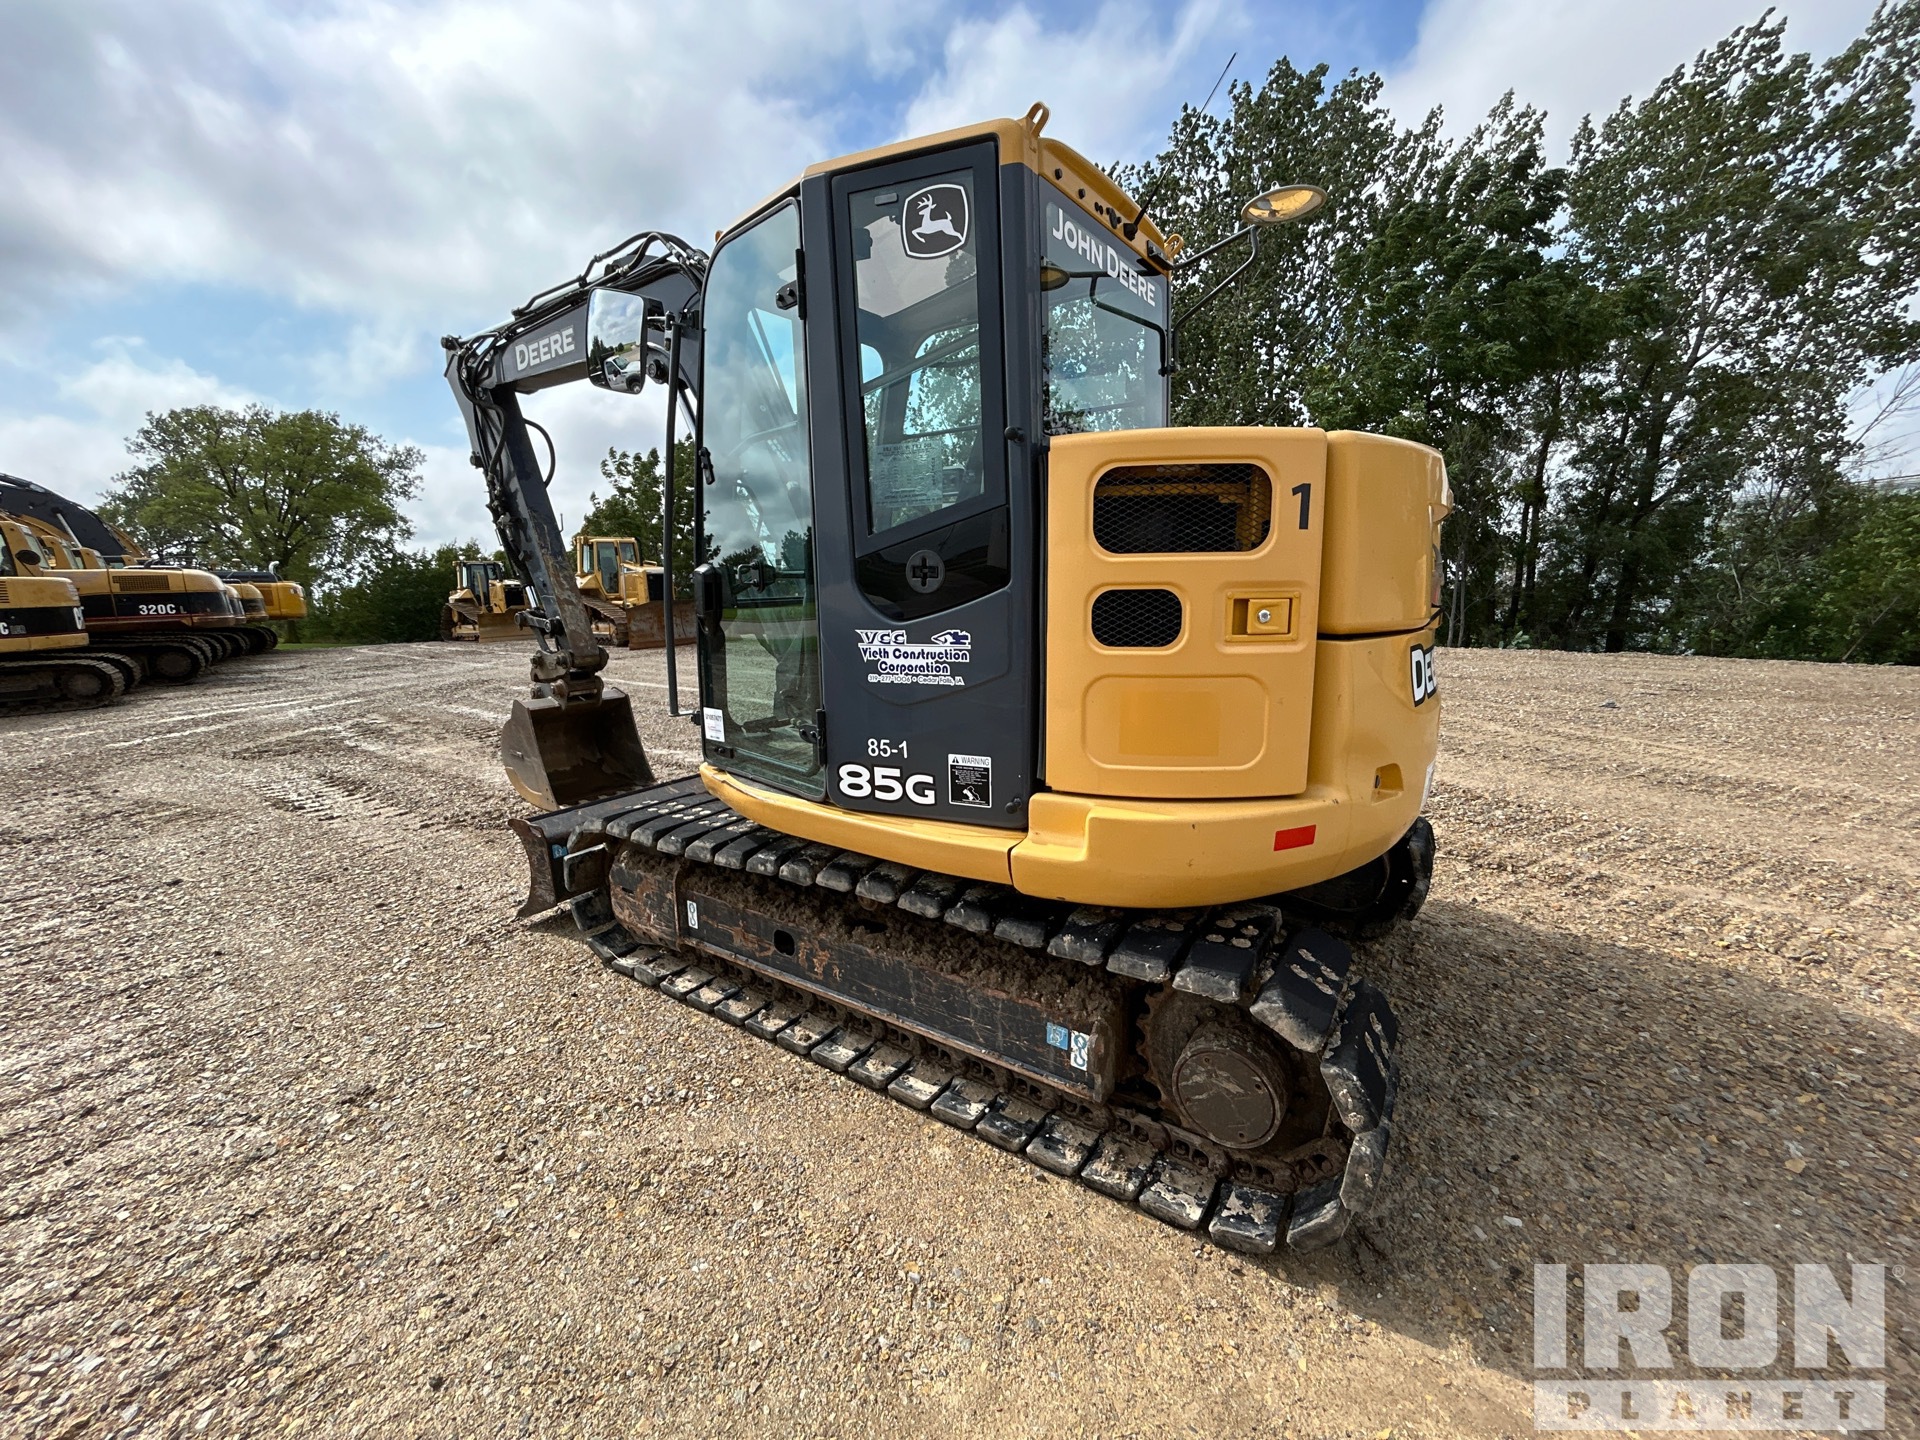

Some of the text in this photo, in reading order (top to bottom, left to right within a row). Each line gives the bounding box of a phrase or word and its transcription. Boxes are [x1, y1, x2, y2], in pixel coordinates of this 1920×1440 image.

[1052, 208, 1156, 307] JOHN DEERE
[514, 325, 576, 371] DEERE
[1291, 483, 1312, 530] 1
[139, 603, 176, 615] 320C
[859, 630, 907, 645] VCC
[861, 647, 969, 661] Vieth Construction
[879, 660, 950, 675] Corporation
[1410, 647, 1437, 703] DE
[867, 738, 908, 759] 85-1
[960, 756, 990, 766] WARNING
[838, 763, 936, 805] 85G
